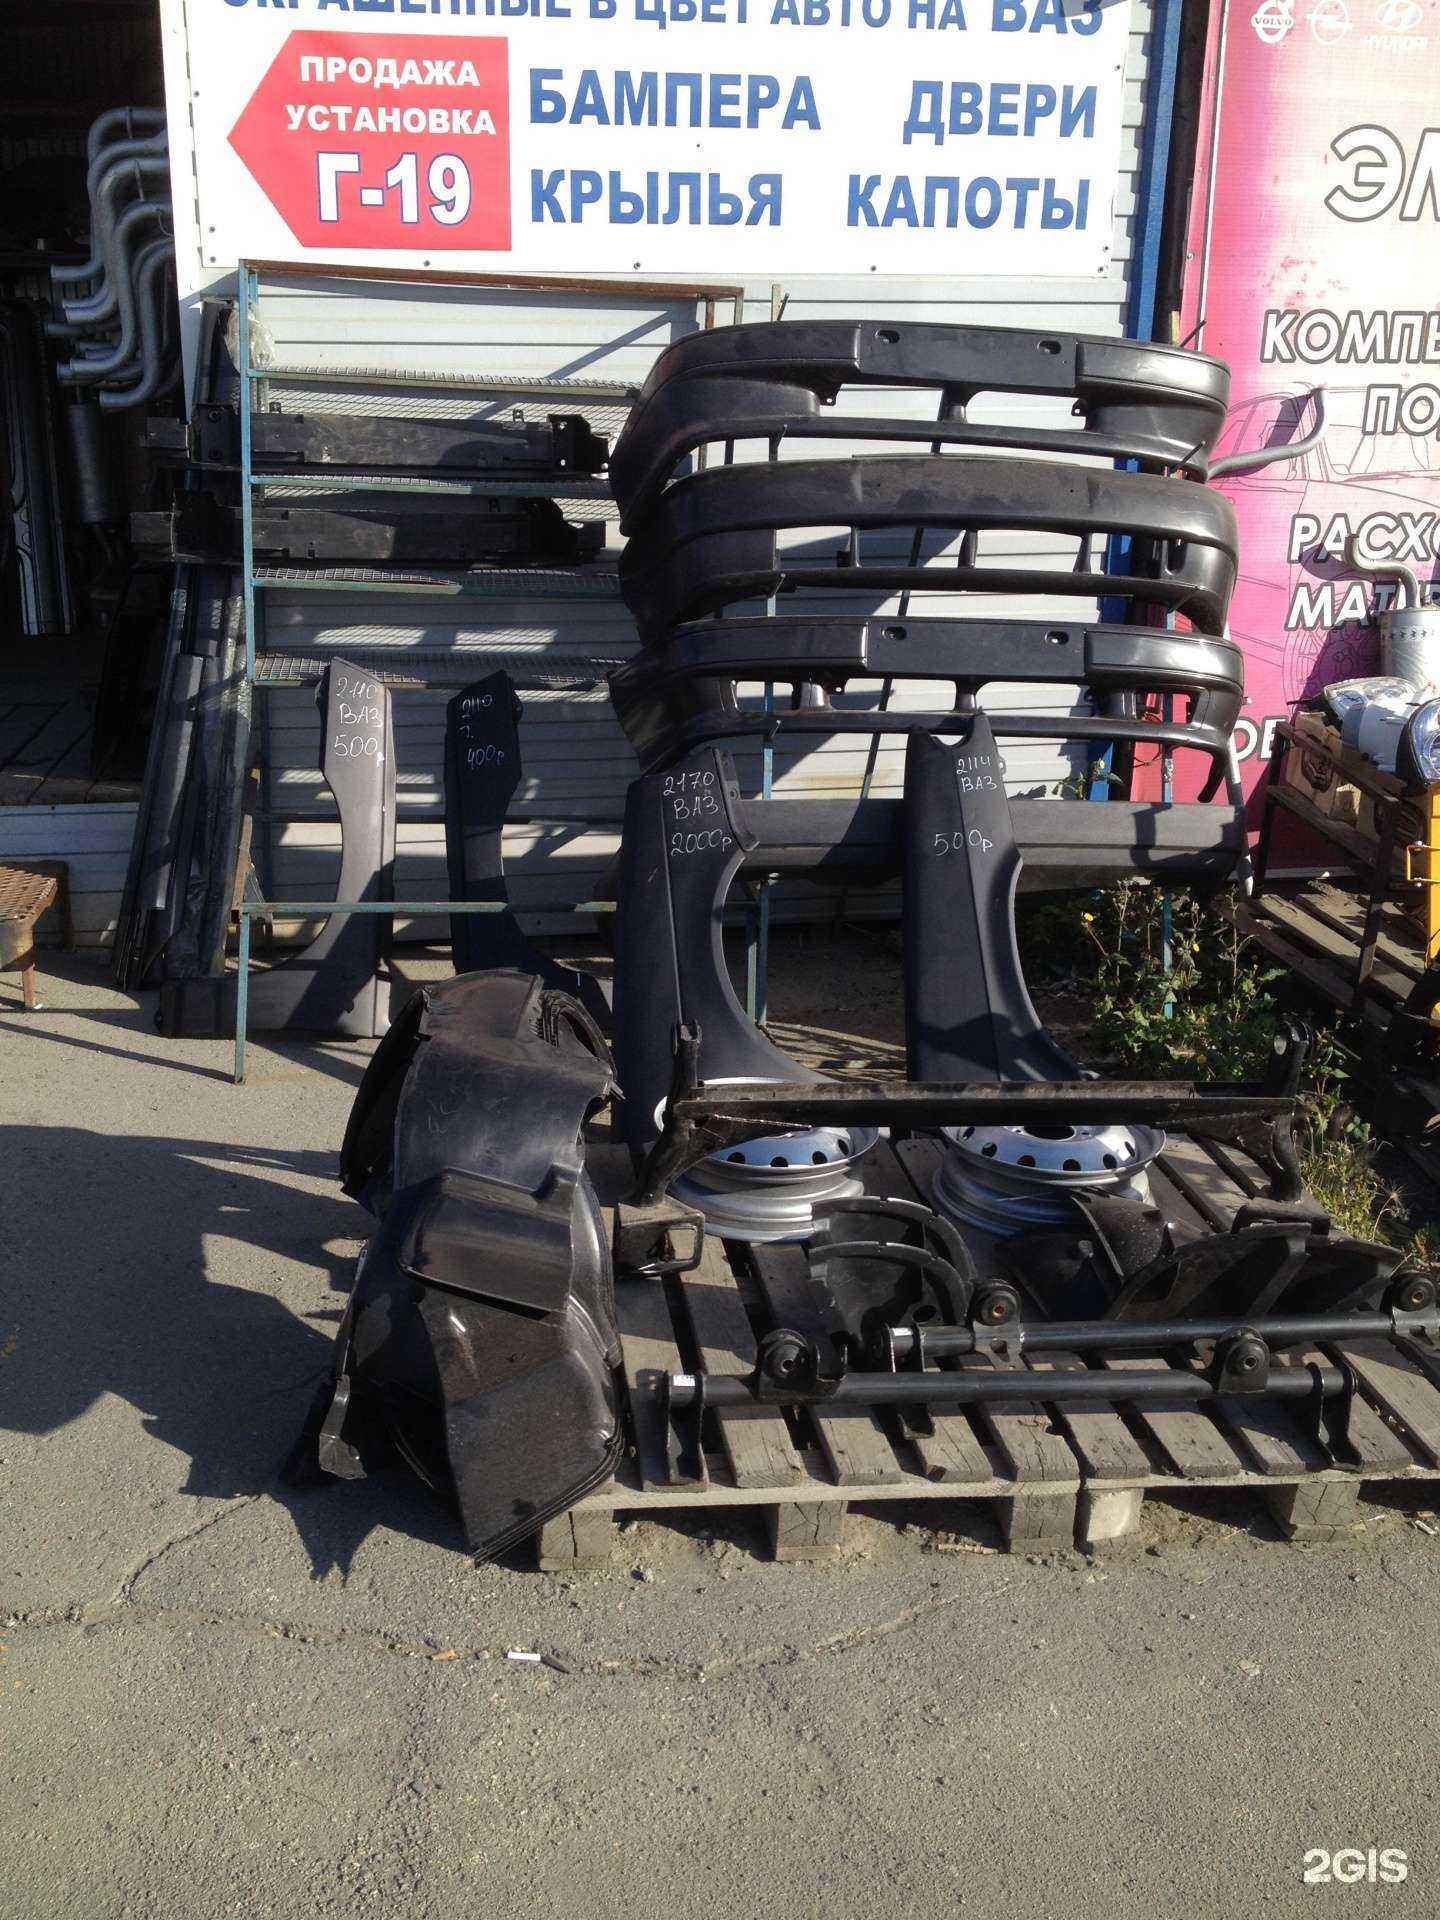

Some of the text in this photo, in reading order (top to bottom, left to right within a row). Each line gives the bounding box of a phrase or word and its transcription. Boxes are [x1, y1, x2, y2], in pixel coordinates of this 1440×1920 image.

[1254, 17, 1292, 26] VOLVO
[300, 55, 481, 89] ПРОДАЖА
[529, 68, 1098, 145] БАМПЕРА ДВЕРИ
[284, 105, 496, 136] УСТАНОВКА
[316, 152, 472, 226] Г-19
[530, 168, 1091, 231] КРЫЛЬЯ КАПОТЫ
[1362, 382, 1440, 441] ПО
[1287, 511, 1440, 563] РАСХ
[339, 703, 384, 728] ВАЗ
[956, 756, 991, 775] 2114
[663, 771, 715, 796] 2170
[961, 775, 998, 792] ВАЗ
[674, 796, 719, 819] ВАЗ
[671, 829, 732, 856] 2000р
[934, 829, 993, 856] 500р
